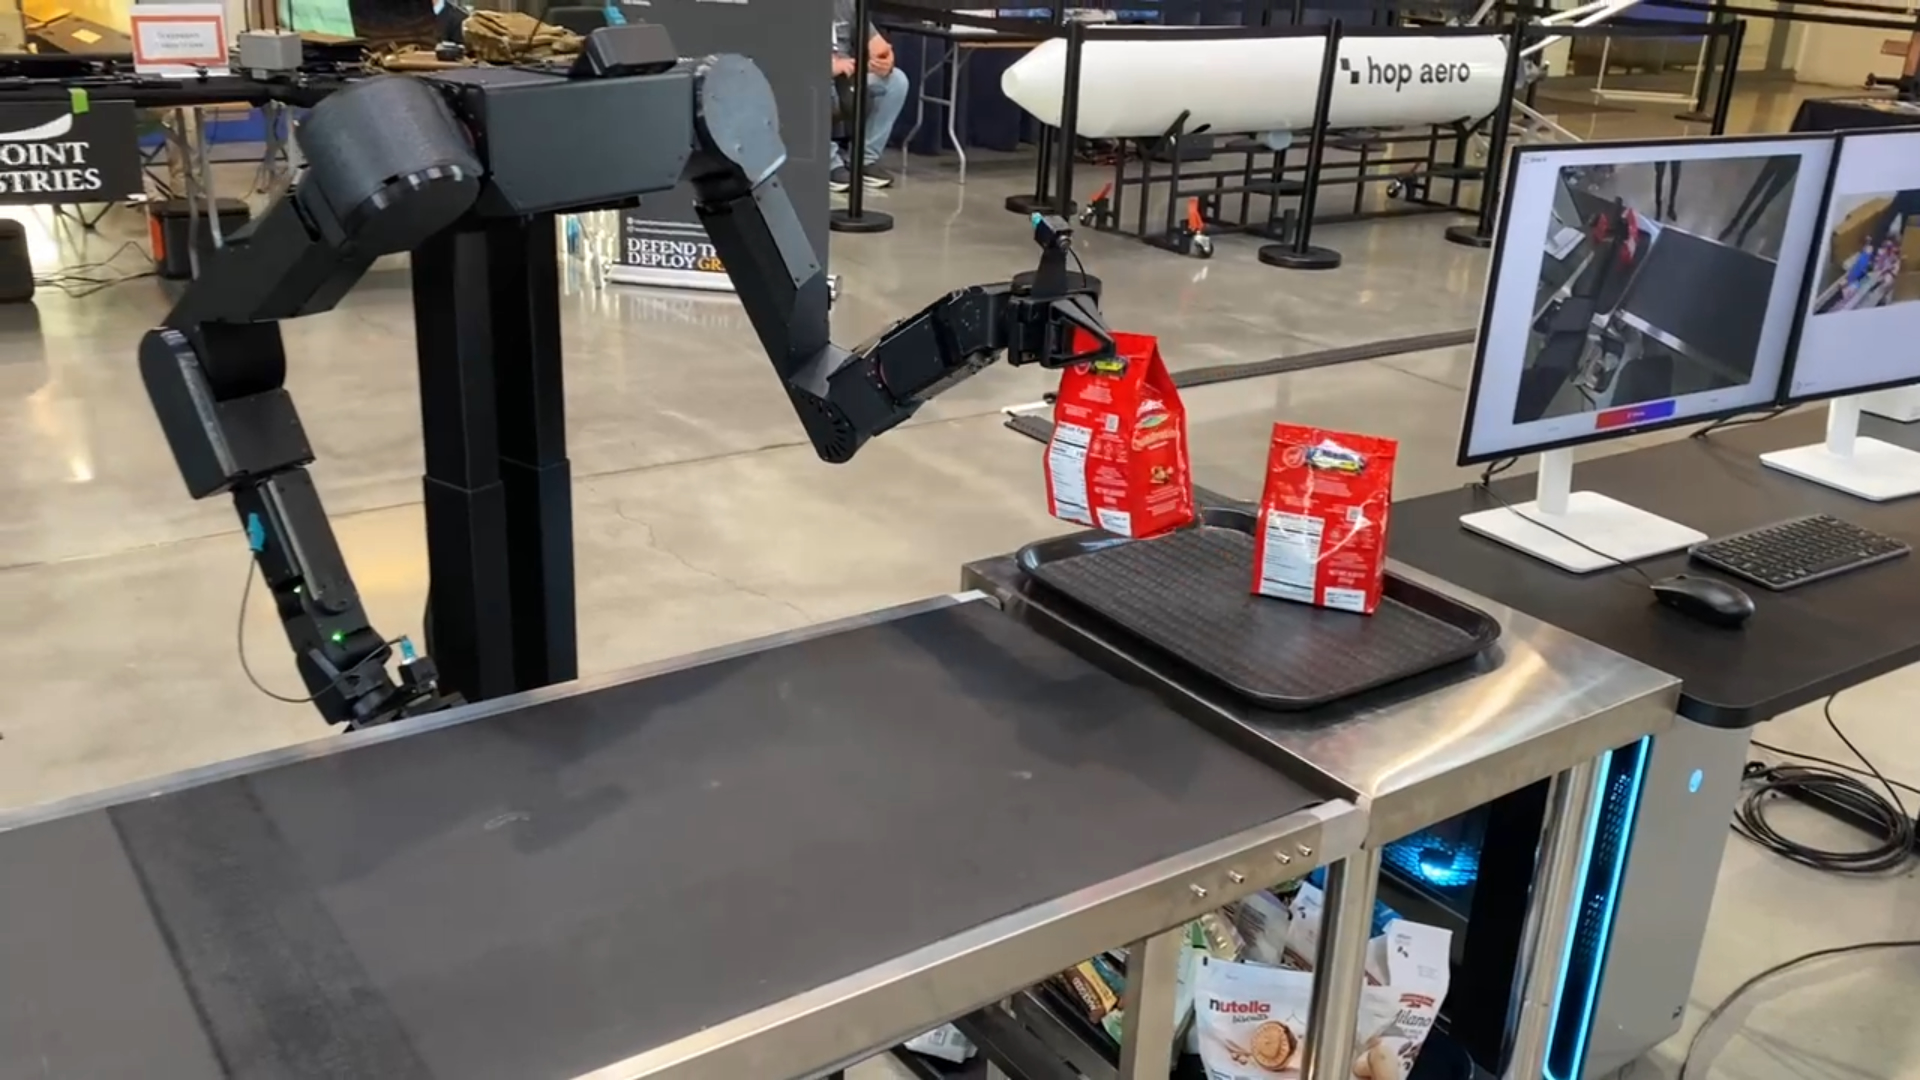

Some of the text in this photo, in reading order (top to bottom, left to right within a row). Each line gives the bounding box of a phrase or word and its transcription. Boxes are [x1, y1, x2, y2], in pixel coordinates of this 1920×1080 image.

[1367, 56, 1470, 92] hop aero
[0, 142, 89, 166] OINT
[627, 238, 697, 256] DEFEND
[628, 252, 696, 269] DEPLOY
[1209, 998, 1271, 1014] nutella
